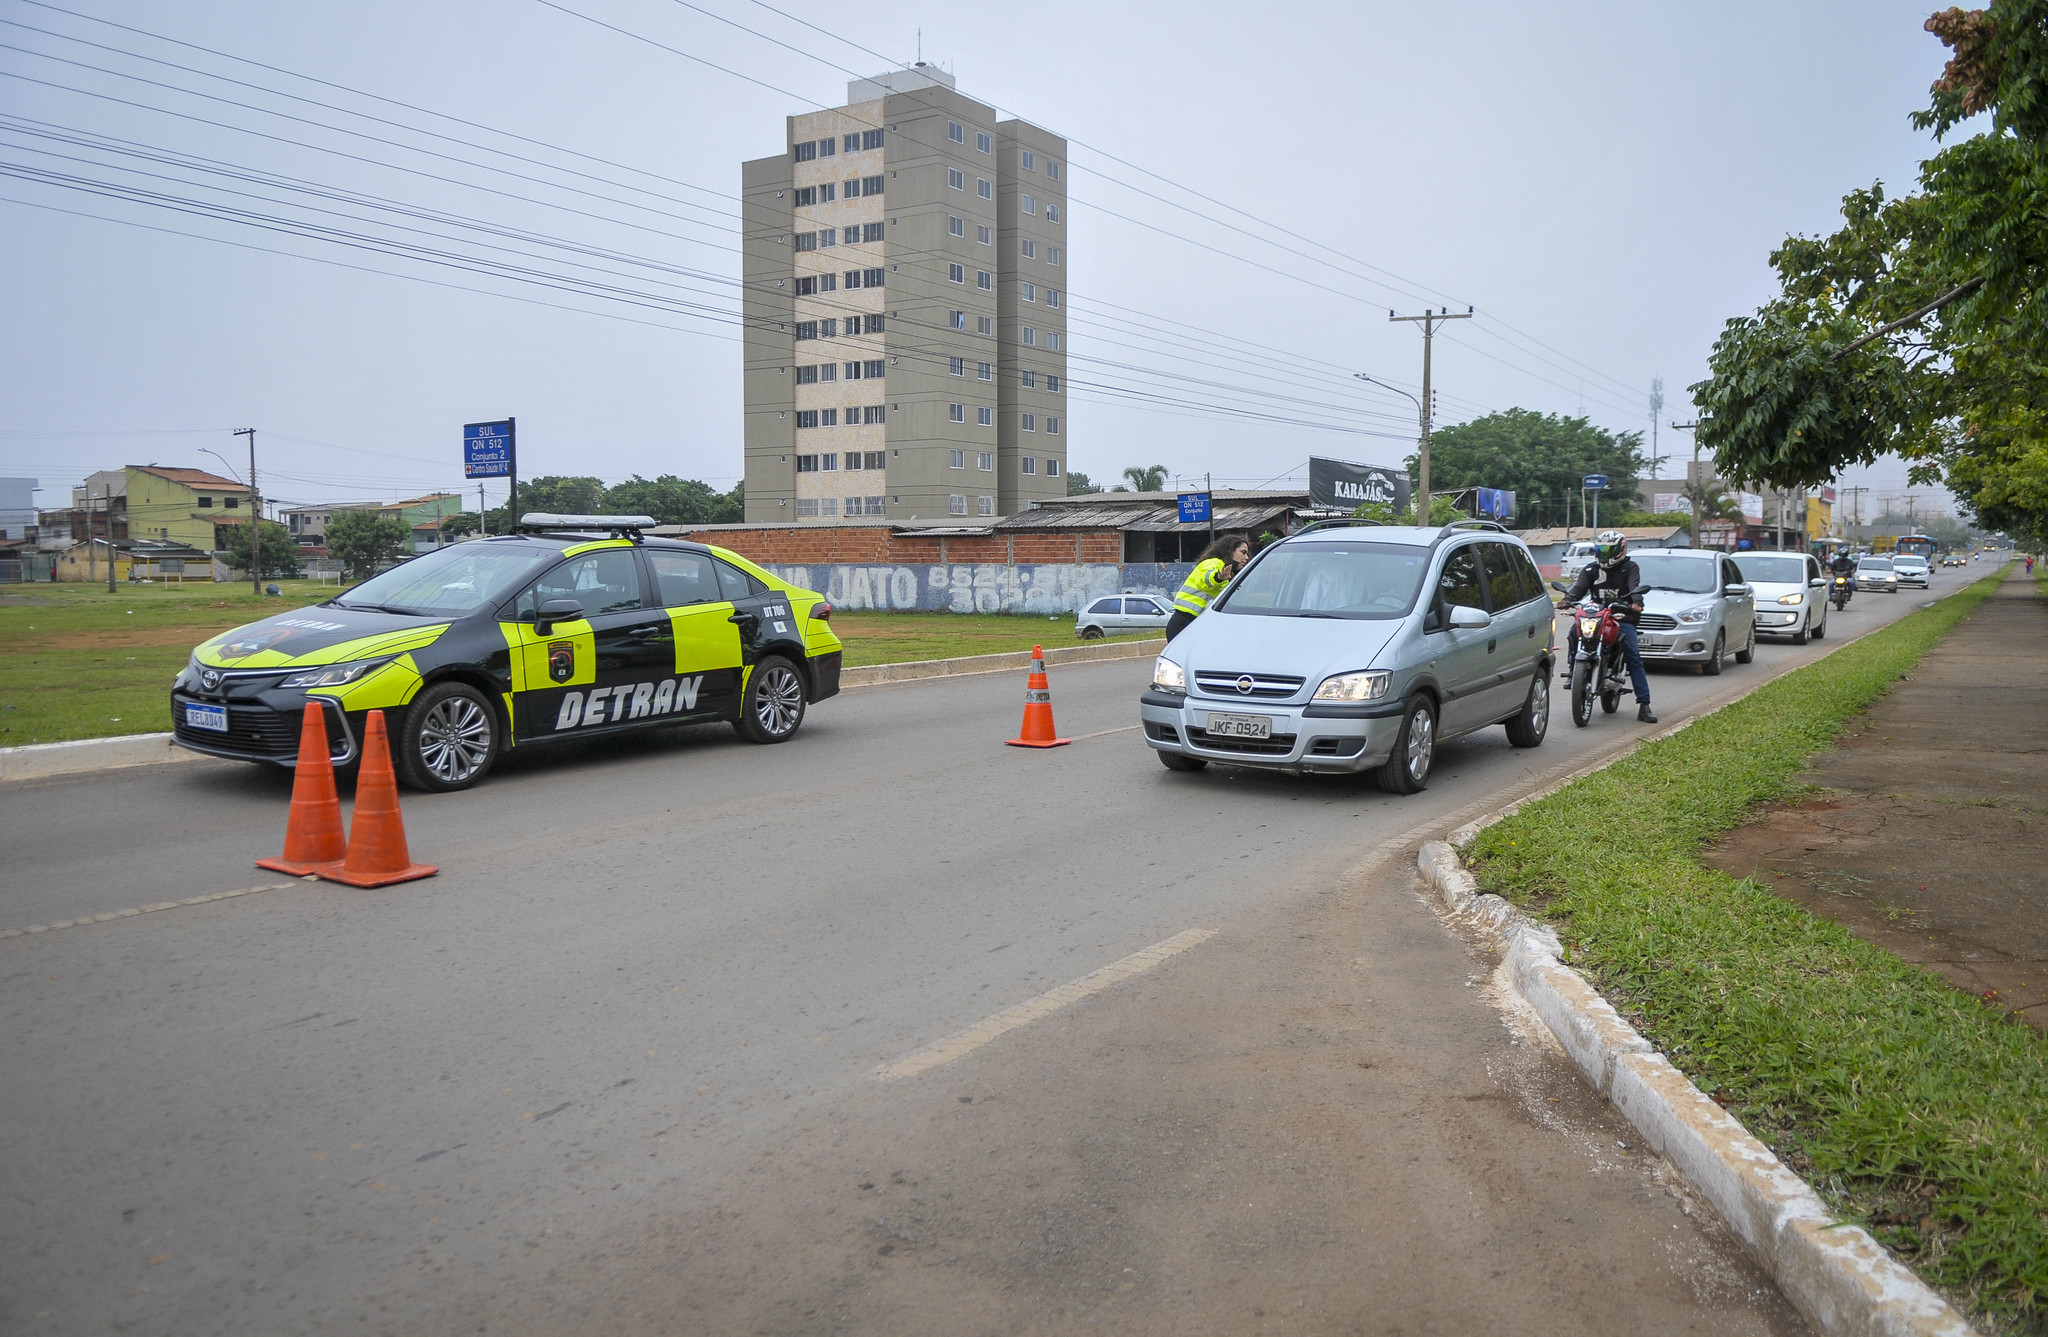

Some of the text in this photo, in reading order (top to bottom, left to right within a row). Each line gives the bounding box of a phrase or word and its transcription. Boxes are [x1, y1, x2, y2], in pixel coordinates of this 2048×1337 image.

[479, 427, 495, 436] SUL
[472, 439, 502, 450] QN 512
[471, 450, 505, 462] Conjunto 2
[1334, 480, 1383, 502] KARAJÁS
[825, 565, 918, 609] JATO
[555, 675, 703, 730] DETRAN
